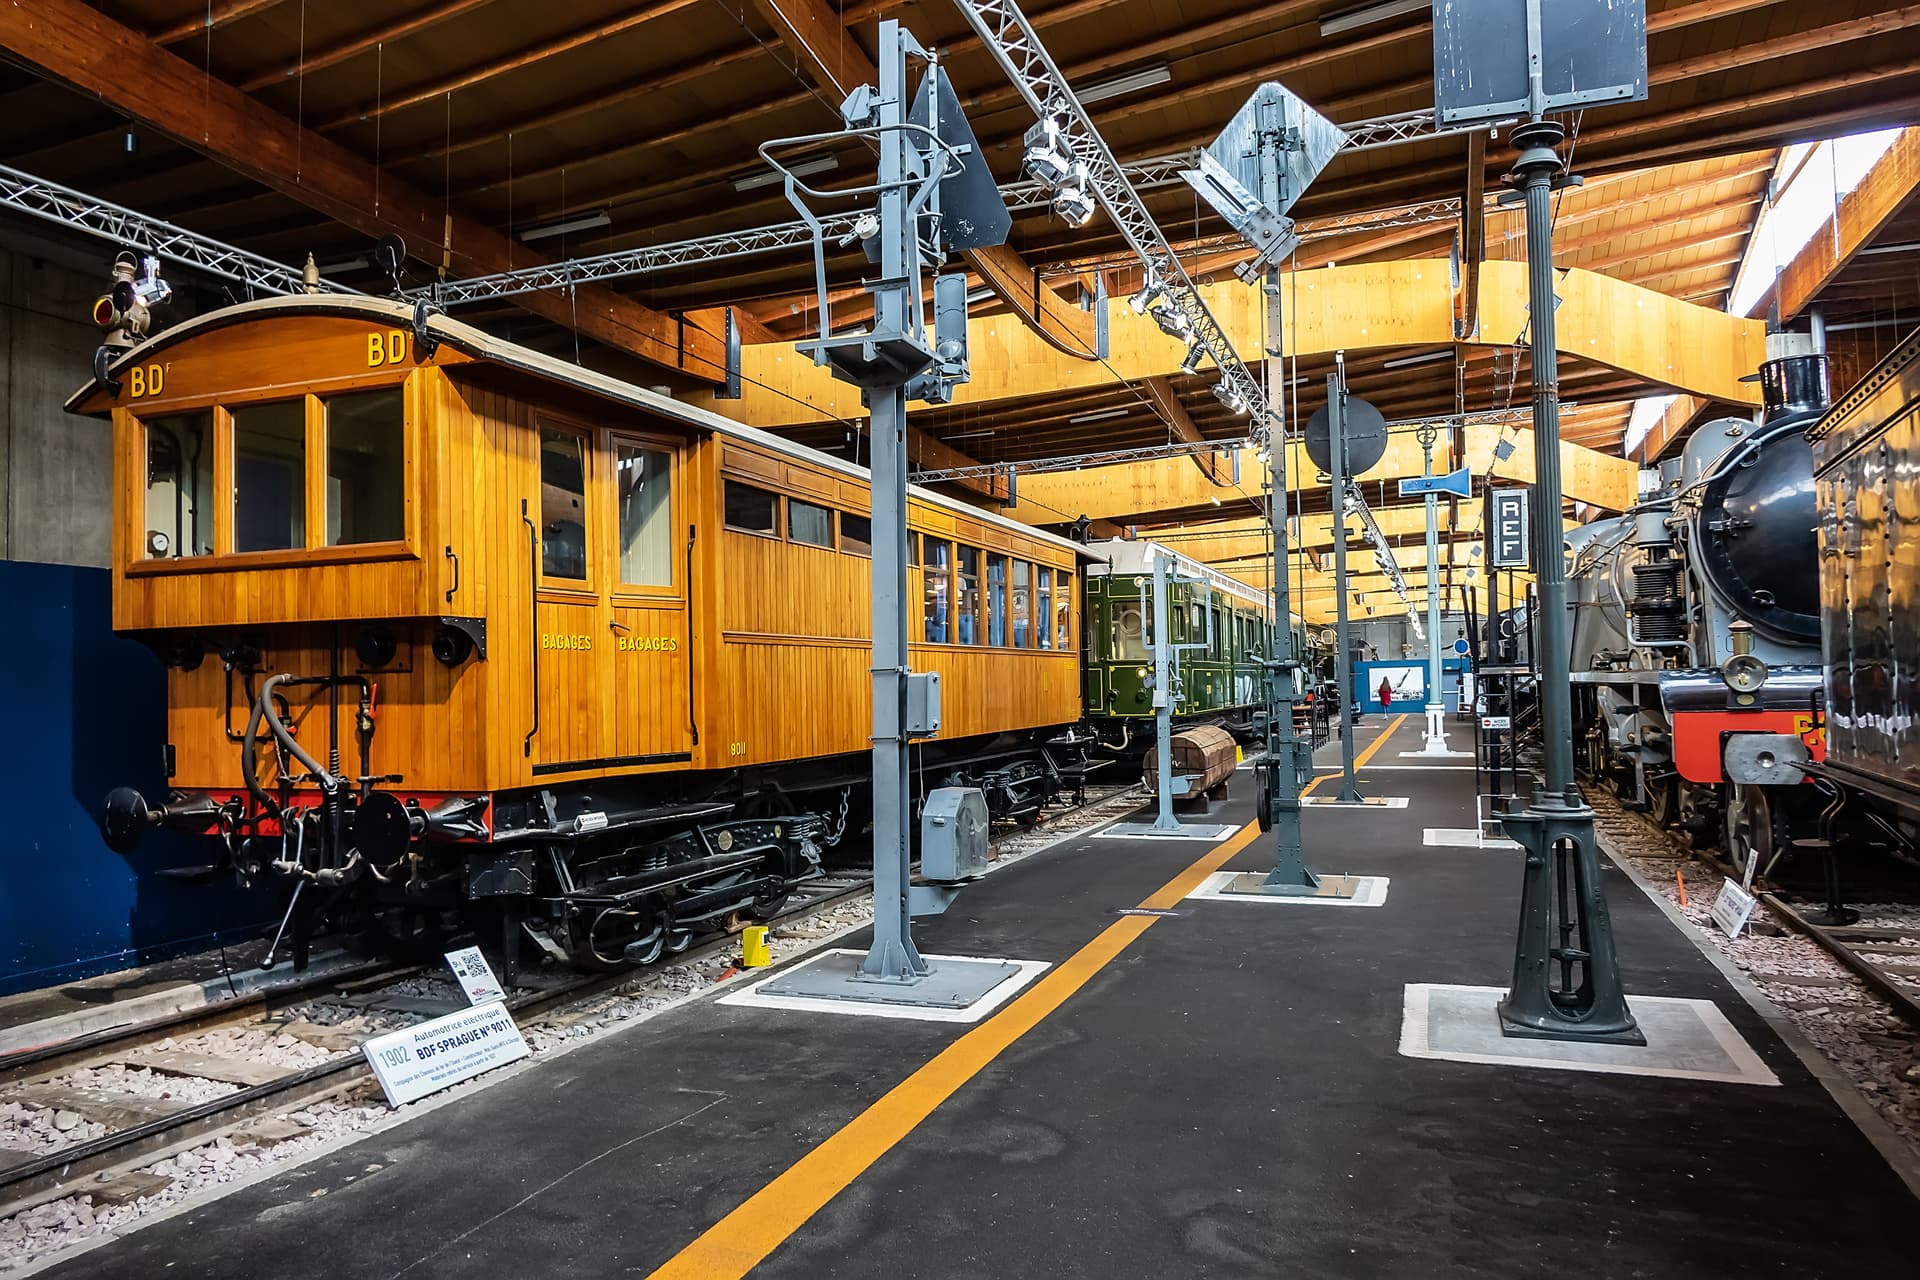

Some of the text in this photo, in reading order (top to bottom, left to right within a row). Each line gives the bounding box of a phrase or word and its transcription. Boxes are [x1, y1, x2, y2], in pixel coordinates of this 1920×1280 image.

[1502, 501, 1520, 557] REF
[543, 634, 592, 650] BAGAGES
[619, 635, 678, 651] BAGAGES
[730, 742, 746, 756] 9011
[414, 1022, 463, 1043] Automotrice
[416, 1044, 437, 1060] BDF
[436, 1029, 483, 1053] SPRAGUE
[479, 1025, 491, 1038] N°
[491, 1018, 513, 1035] 9011
[379, 1045, 412, 1069] 1902
